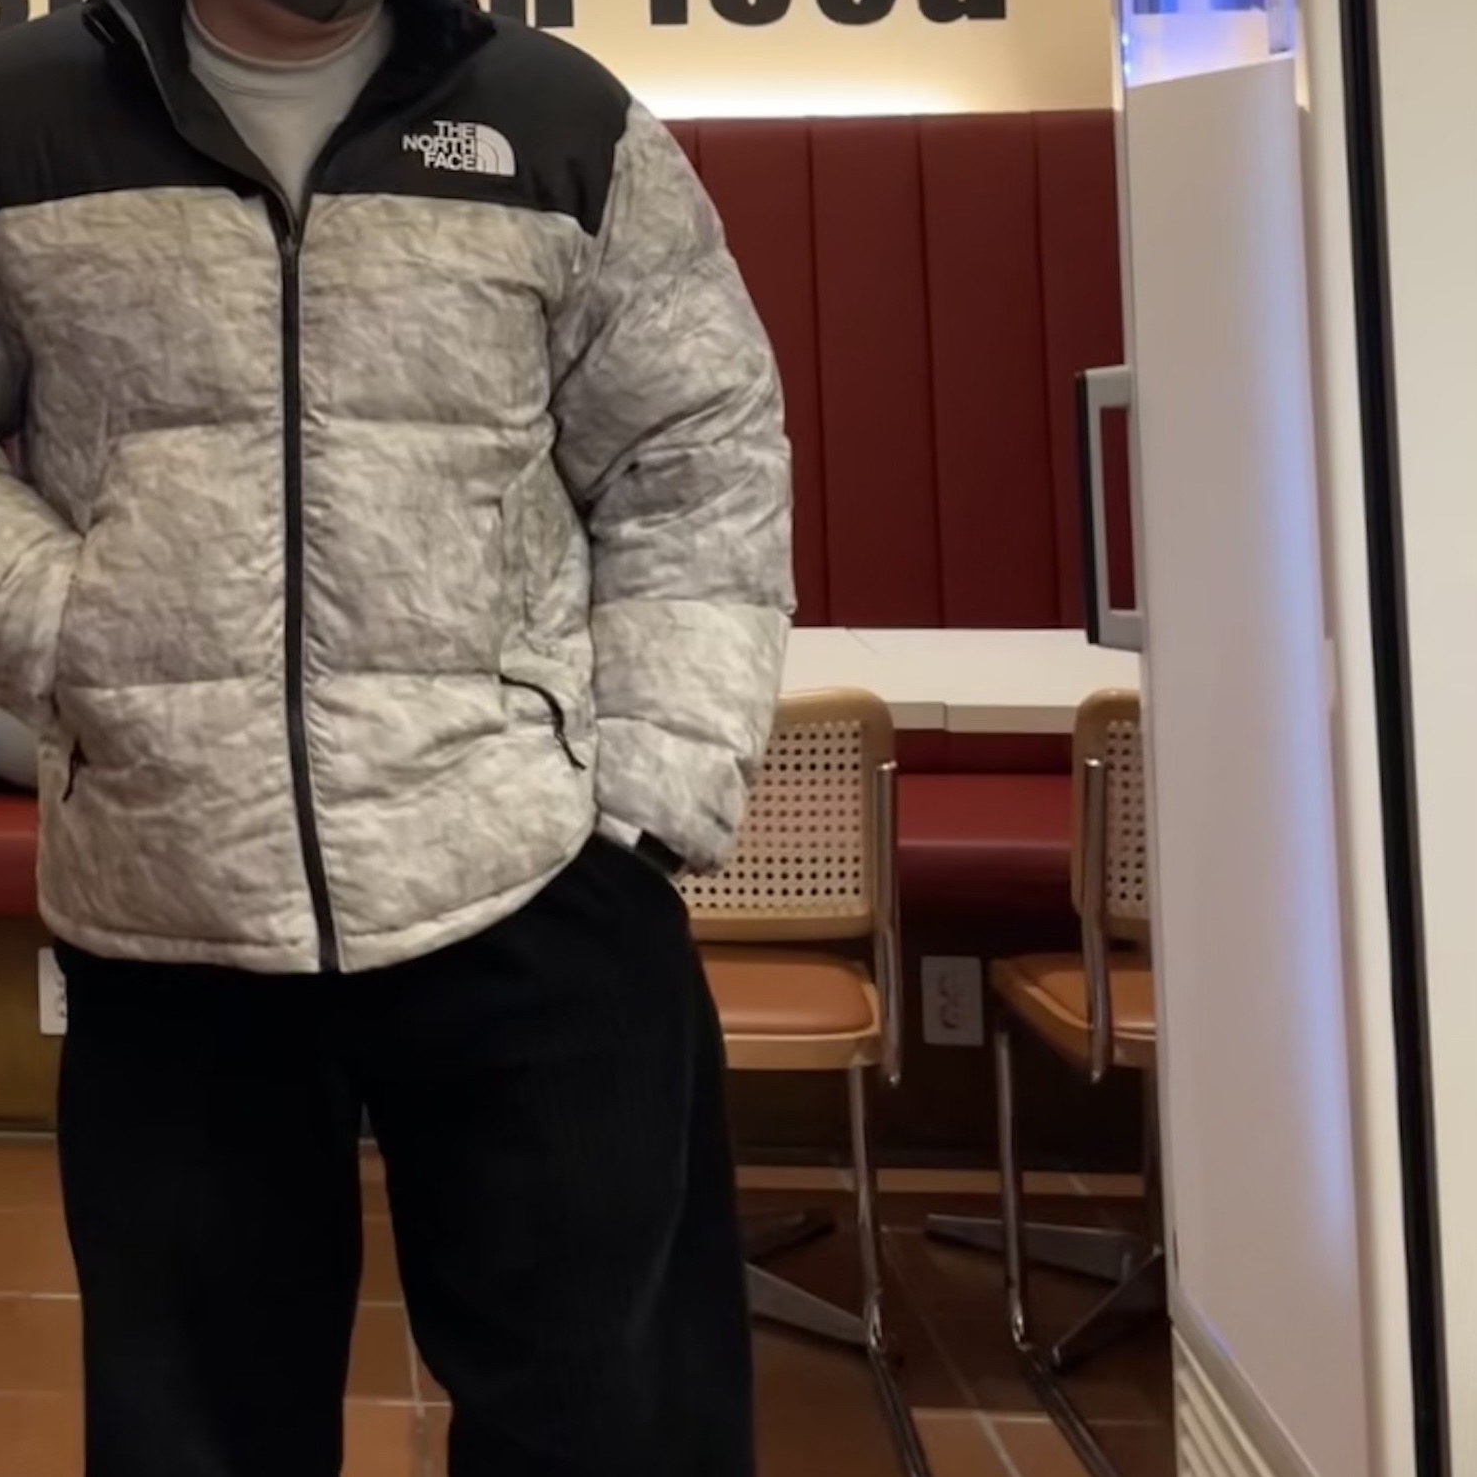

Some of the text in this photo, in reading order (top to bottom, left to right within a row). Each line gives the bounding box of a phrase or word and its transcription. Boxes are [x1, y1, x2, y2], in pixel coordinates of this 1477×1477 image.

[433, 120, 475, 138] THE
[403, 134, 475, 154] NORTH
[424, 152, 475, 172] FACE
